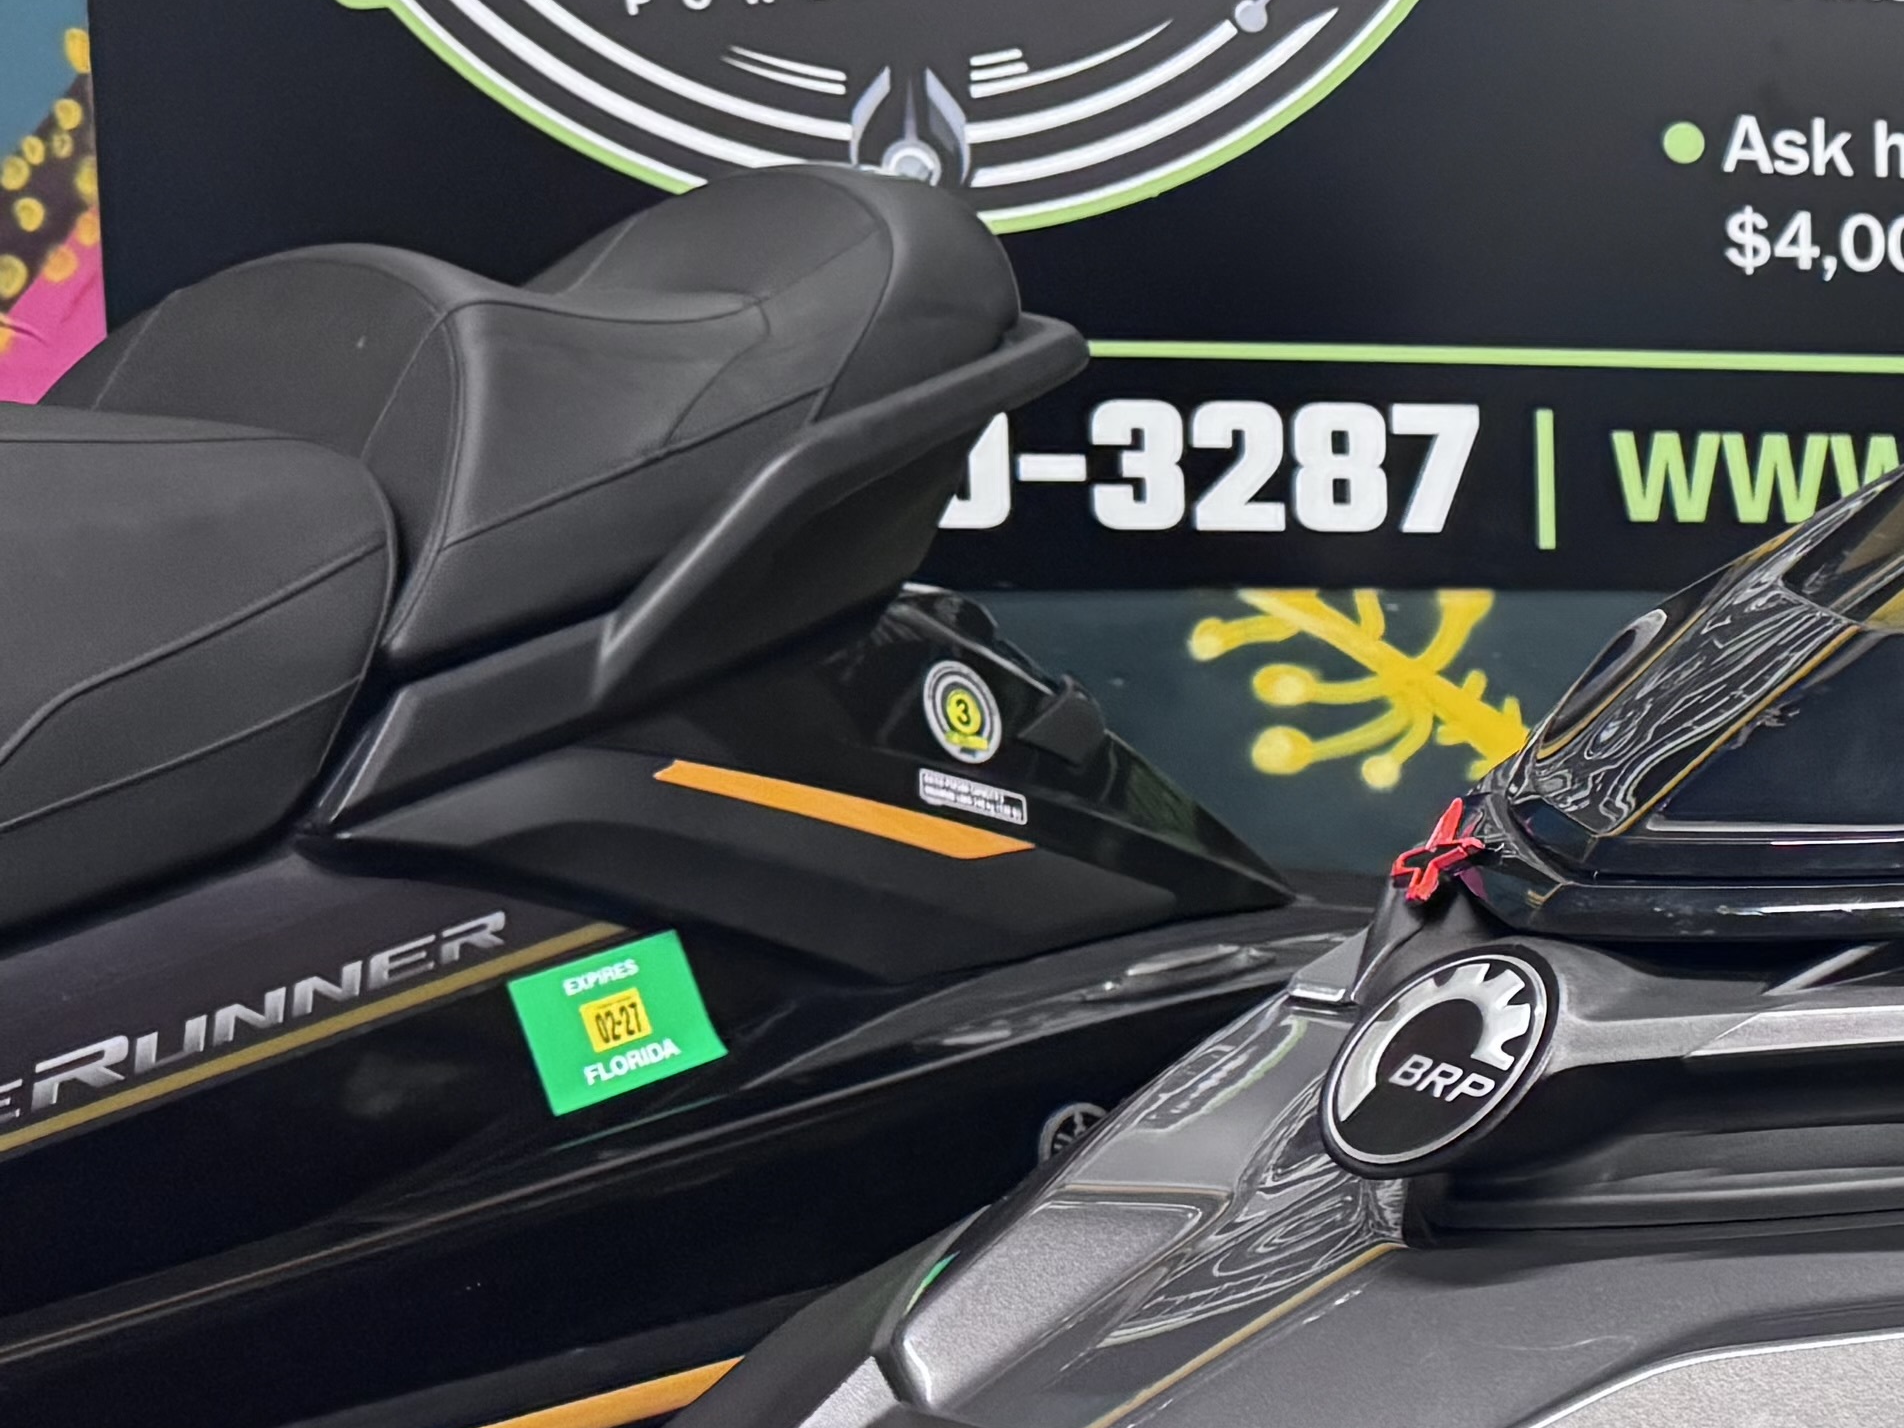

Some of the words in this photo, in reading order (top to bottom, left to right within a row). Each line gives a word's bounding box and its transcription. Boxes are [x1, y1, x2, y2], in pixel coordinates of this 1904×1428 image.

[1721, 113, 1856, 180] Ask
[955, 698, 972, 726] 3
[562, 958, 640, 996] EXPIRES
[0, 910, 507, 1122] RUNNER
[594, 1002, 643, 1044] 02-27
[582, 1037, 682, 1086] FLORIDA
[1390, 1054, 1496, 1102] BRP
